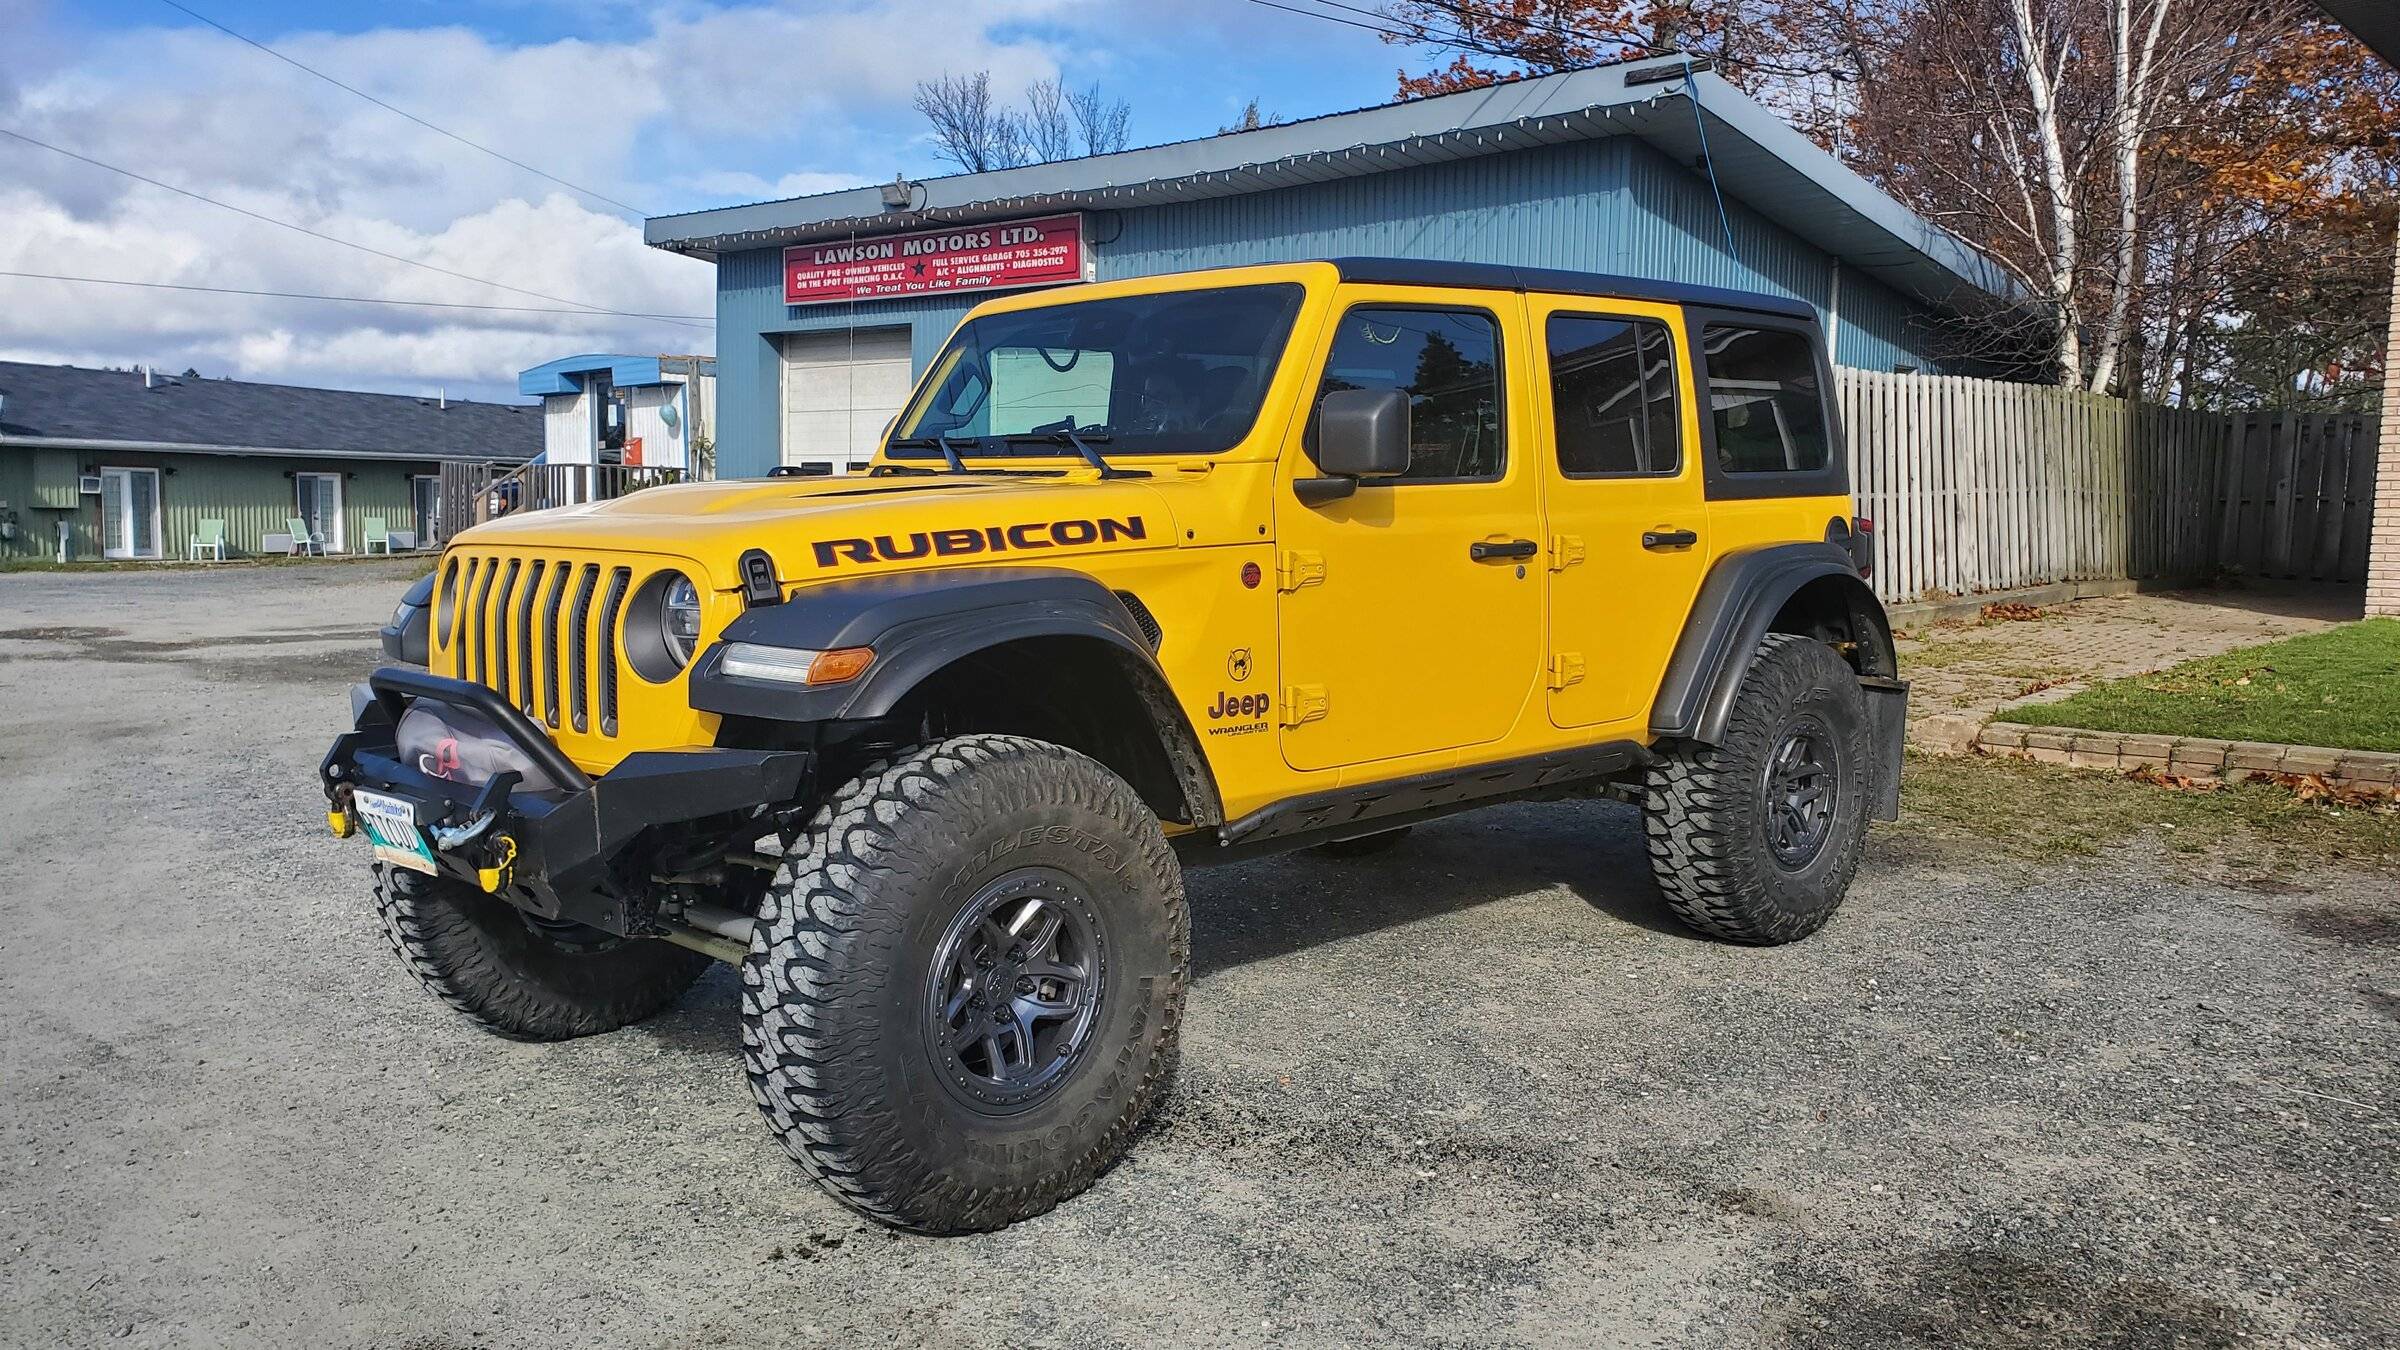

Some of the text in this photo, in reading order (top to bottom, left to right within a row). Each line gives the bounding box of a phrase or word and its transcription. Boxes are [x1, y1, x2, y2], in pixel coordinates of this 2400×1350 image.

[813, 226, 1045, 265] LAWSON MOTORS LTD.
[932, 246, 1068, 267] FULL SERVICE GARAGE 705 356-2974
[797, 270, 824, 281] QUALITY
[873, 262, 905, 273] VEHICLES
[936, 257, 1064, 277] A/C ALIGNMENTS DIAGNOSTICS
[797, 272, 905, 289] ON THE SPOT FINANCING O.A.C.
[876, 282, 902, 293] Treat
[905, 280, 925, 291] You
[929, 278, 951, 289] Like
[955, 274, 993, 287] Family
[811, 515, 1147, 568] RUBICON
[1207, 691, 1270, 720] Jeep
[1208, 721, 1269, 736] WRANGLER
